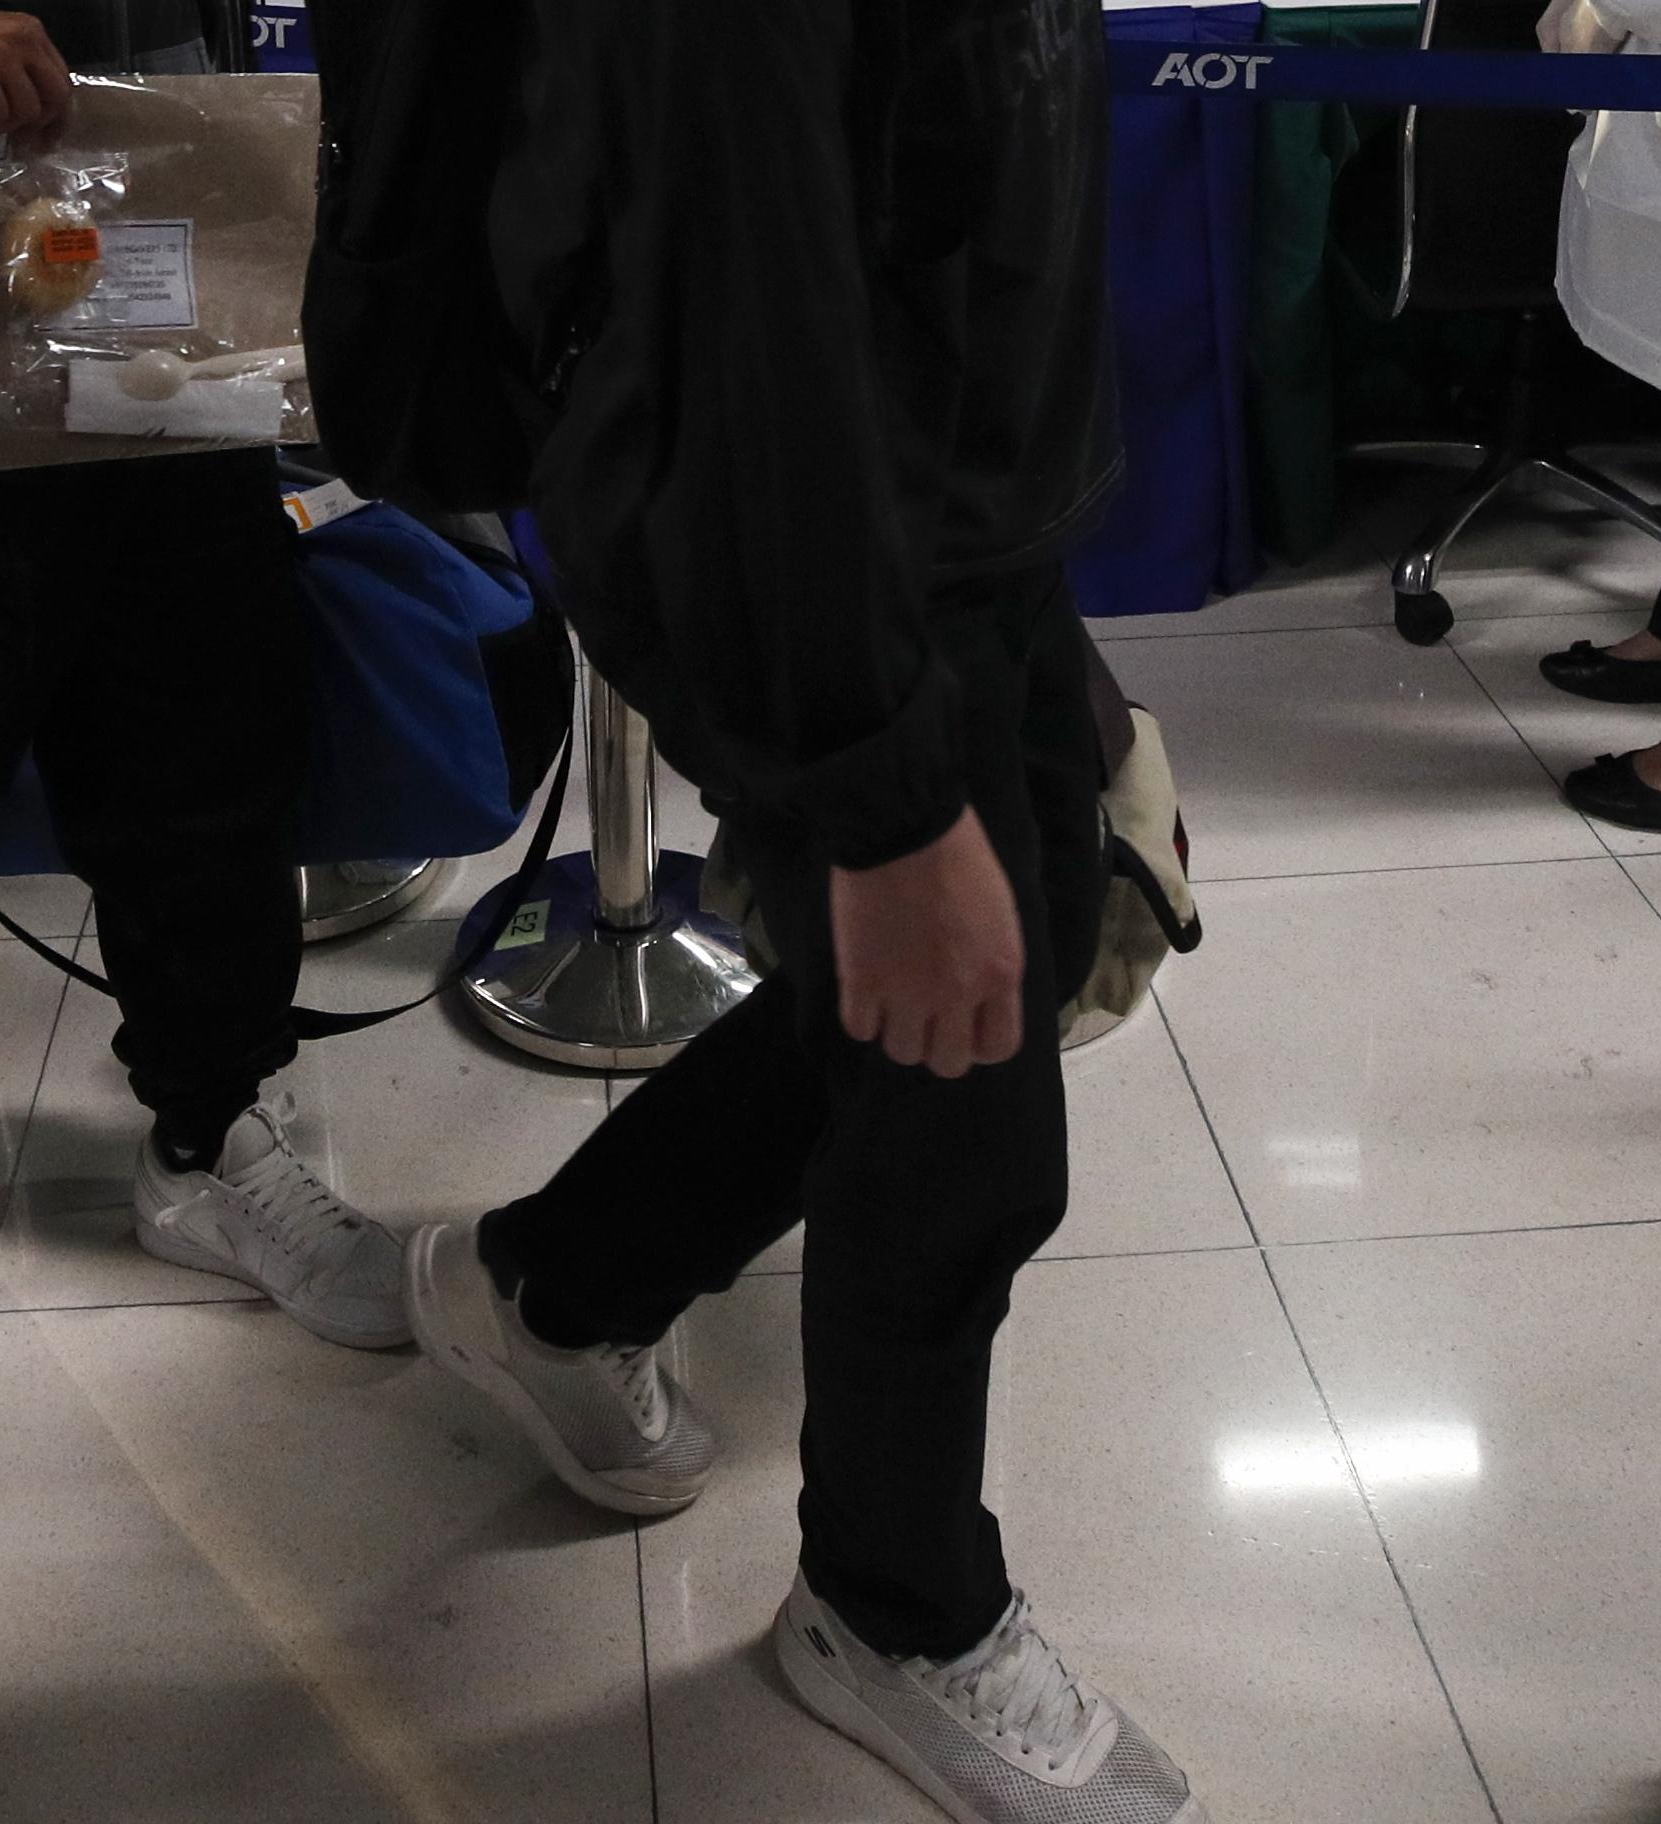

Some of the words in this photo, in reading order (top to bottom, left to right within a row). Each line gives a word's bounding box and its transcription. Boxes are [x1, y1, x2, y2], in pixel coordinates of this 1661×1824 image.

[250, 14, 298, 49] OT
[1150, 52, 1275, 90] AOT
[510, 910, 539, 937] E2
